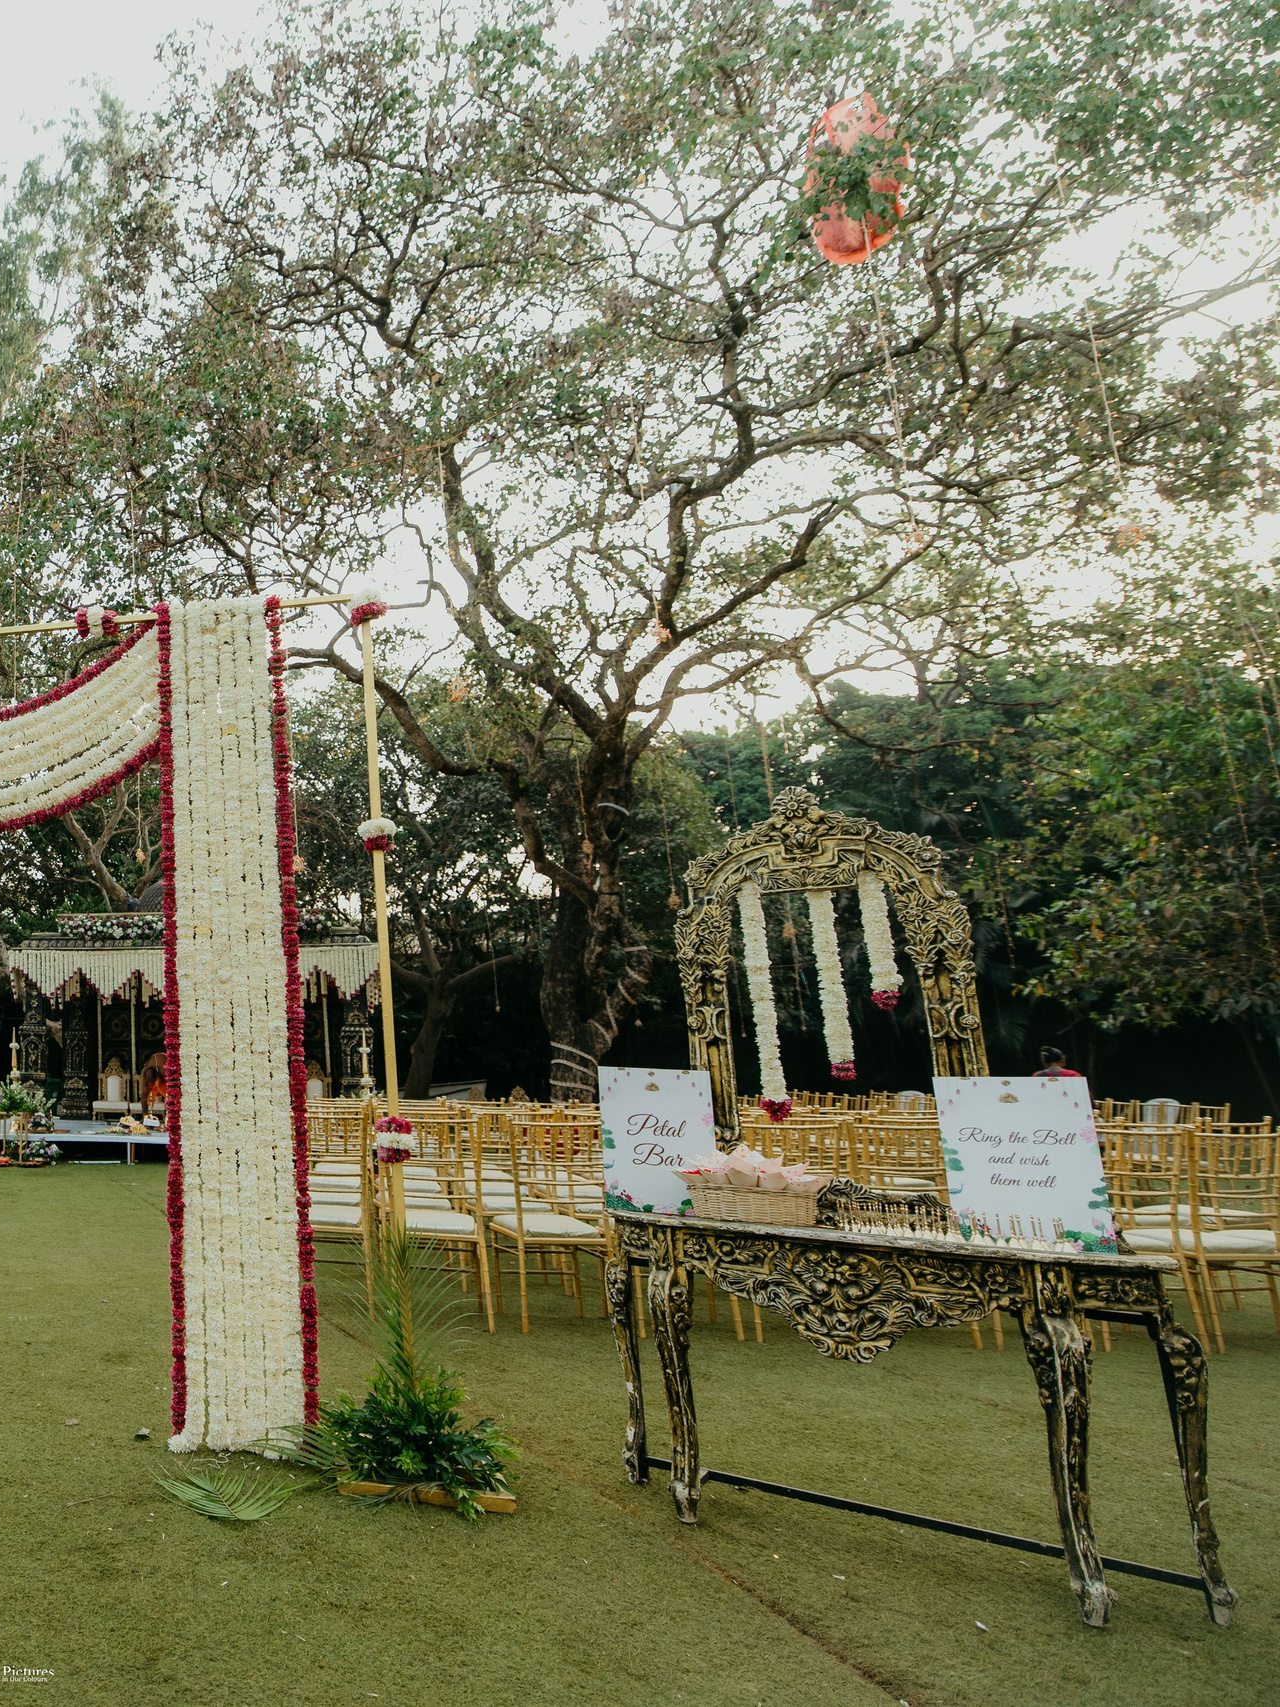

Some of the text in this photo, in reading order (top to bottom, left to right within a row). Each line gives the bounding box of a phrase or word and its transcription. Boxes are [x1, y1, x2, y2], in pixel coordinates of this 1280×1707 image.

[626, 1113, 687, 1138] Petal
[958, 1126, 1078, 1148] Ring the Bell
[632, 1142, 685, 1167] Bar
[988, 1152, 1052, 1167] and wish
[989, 1173, 1057, 1188] them well
